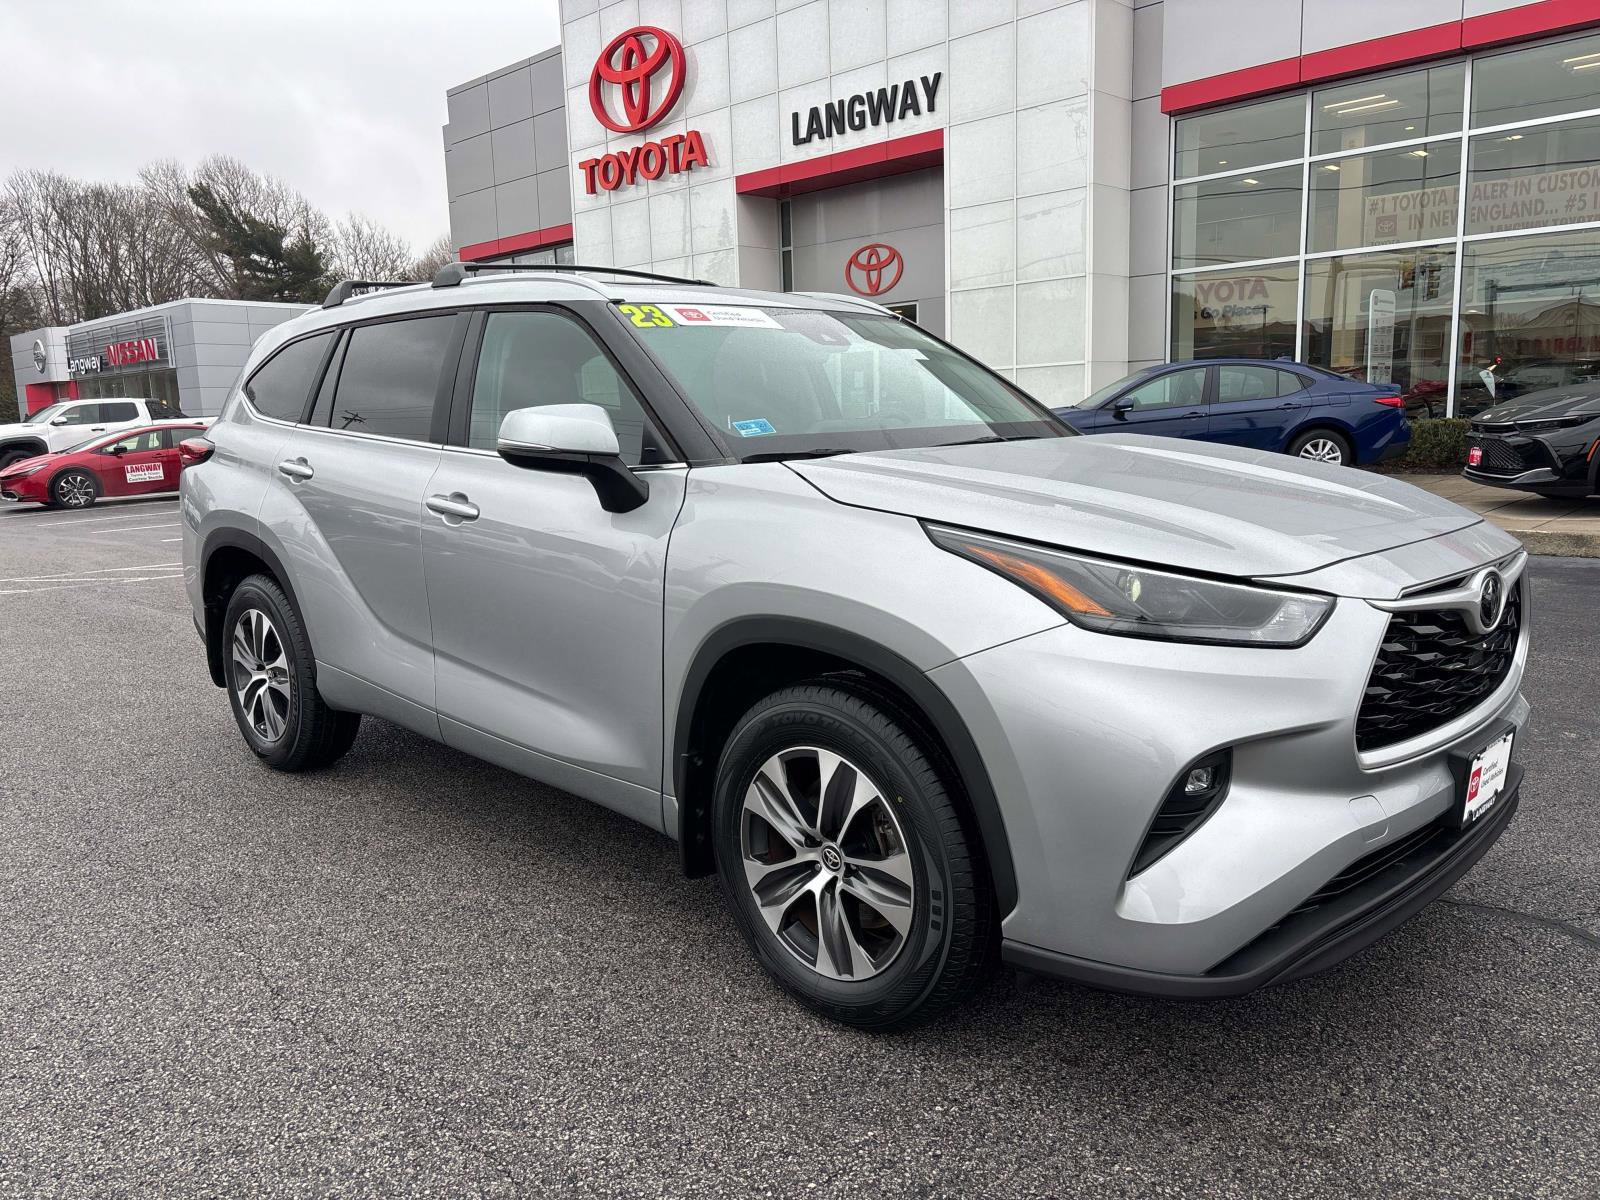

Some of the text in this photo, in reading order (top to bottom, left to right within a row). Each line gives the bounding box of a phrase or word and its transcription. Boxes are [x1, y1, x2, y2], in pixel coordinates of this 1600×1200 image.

[791, 71, 942, 146] LANGWAY
[579, 130, 710, 195] TOYOTA
[1369, 197, 1385, 215] #1
[1392, 189, 1448, 212] TOYOTA
[1453, 181, 1508, 205] DALER
[1513, 178, 1532, 196] IN
[1408, 213, 1424, 231] IN
[1564, 193, 1587, 213] #5
[1196, 276, 1269, 303] YOTA
[619, 304, 674, 328] 23
[66, 337, 158, 374] Langway NISSAN
[126, 463, 161, 474] LANGWAY
